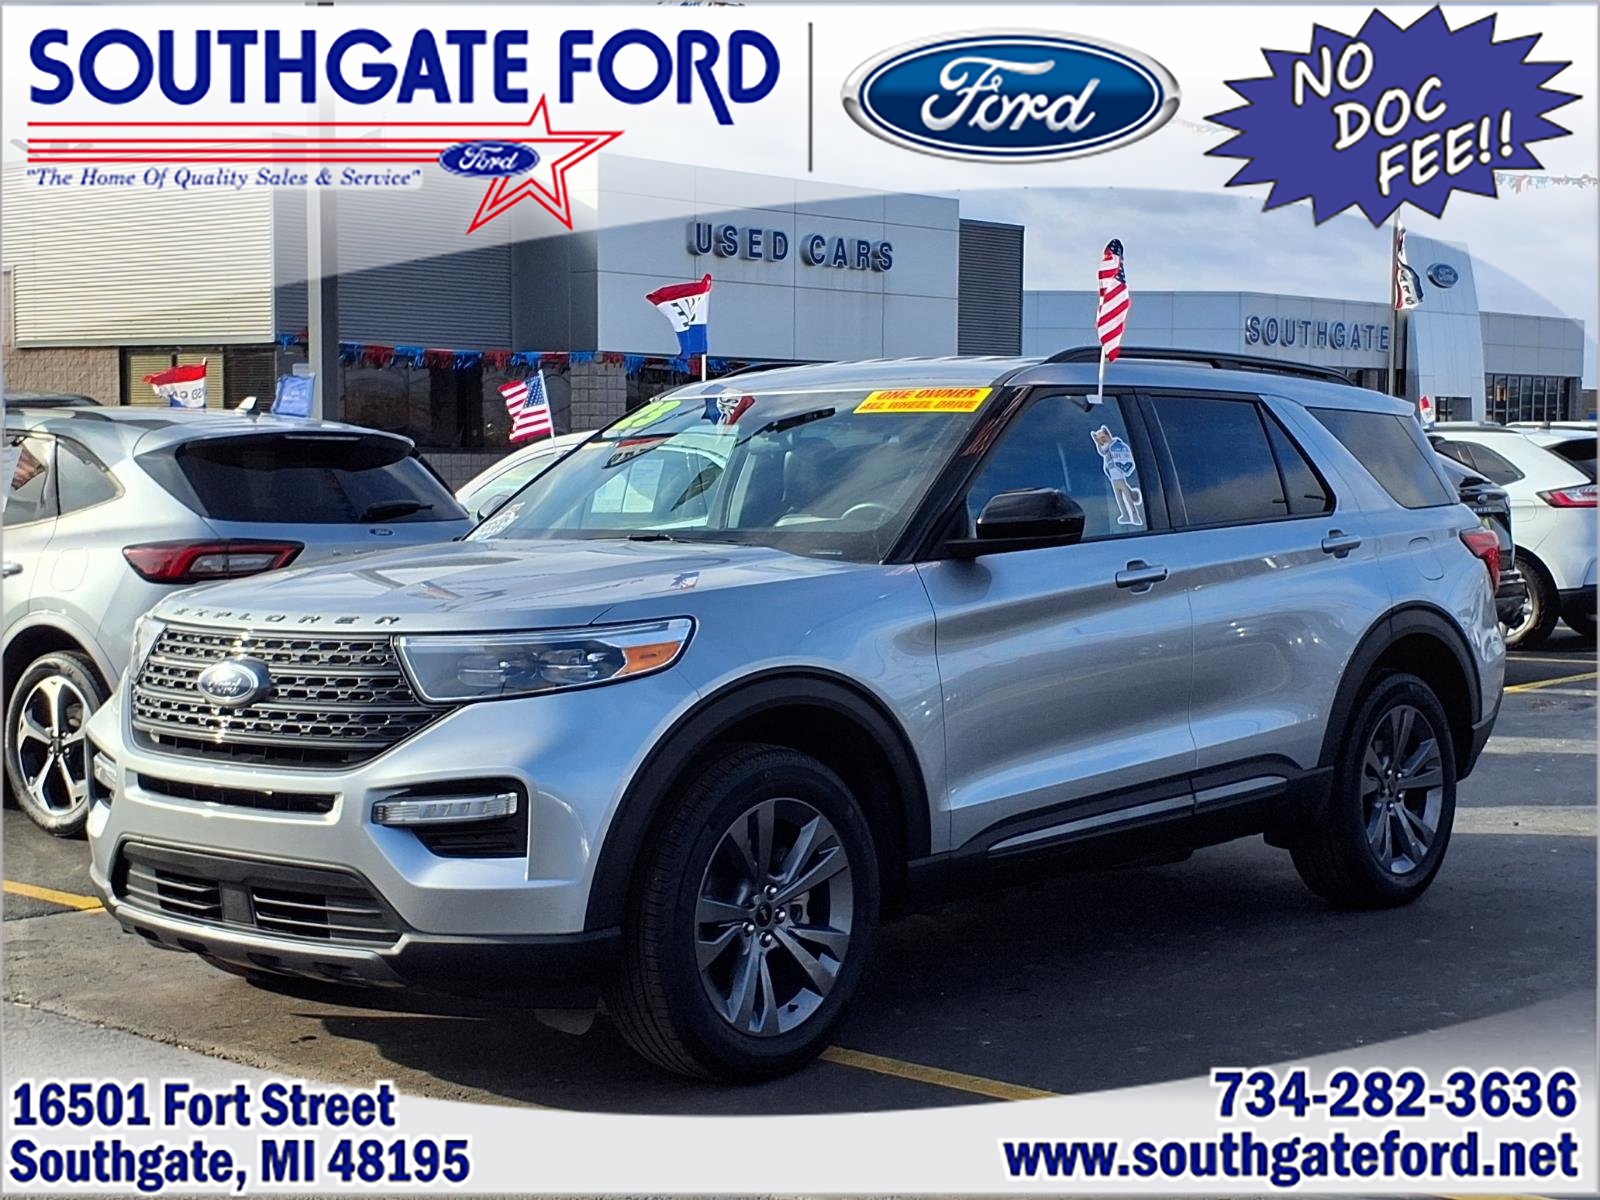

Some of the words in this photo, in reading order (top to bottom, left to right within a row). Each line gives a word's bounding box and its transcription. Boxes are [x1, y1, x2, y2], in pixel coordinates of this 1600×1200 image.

[690, 222, 789, 261] USED
[803, 234, 893, 271] CARS
[1246, 315, 1389, 350] SOUTHGATE
[860, 401, 885, 410] ALL
[887, 400, 932, 409] WHEEL
[933, 400, 978, 409] DRIVE
[876, 390, 914, 400] ONE
[914, 388, 980, 399] OWNER
